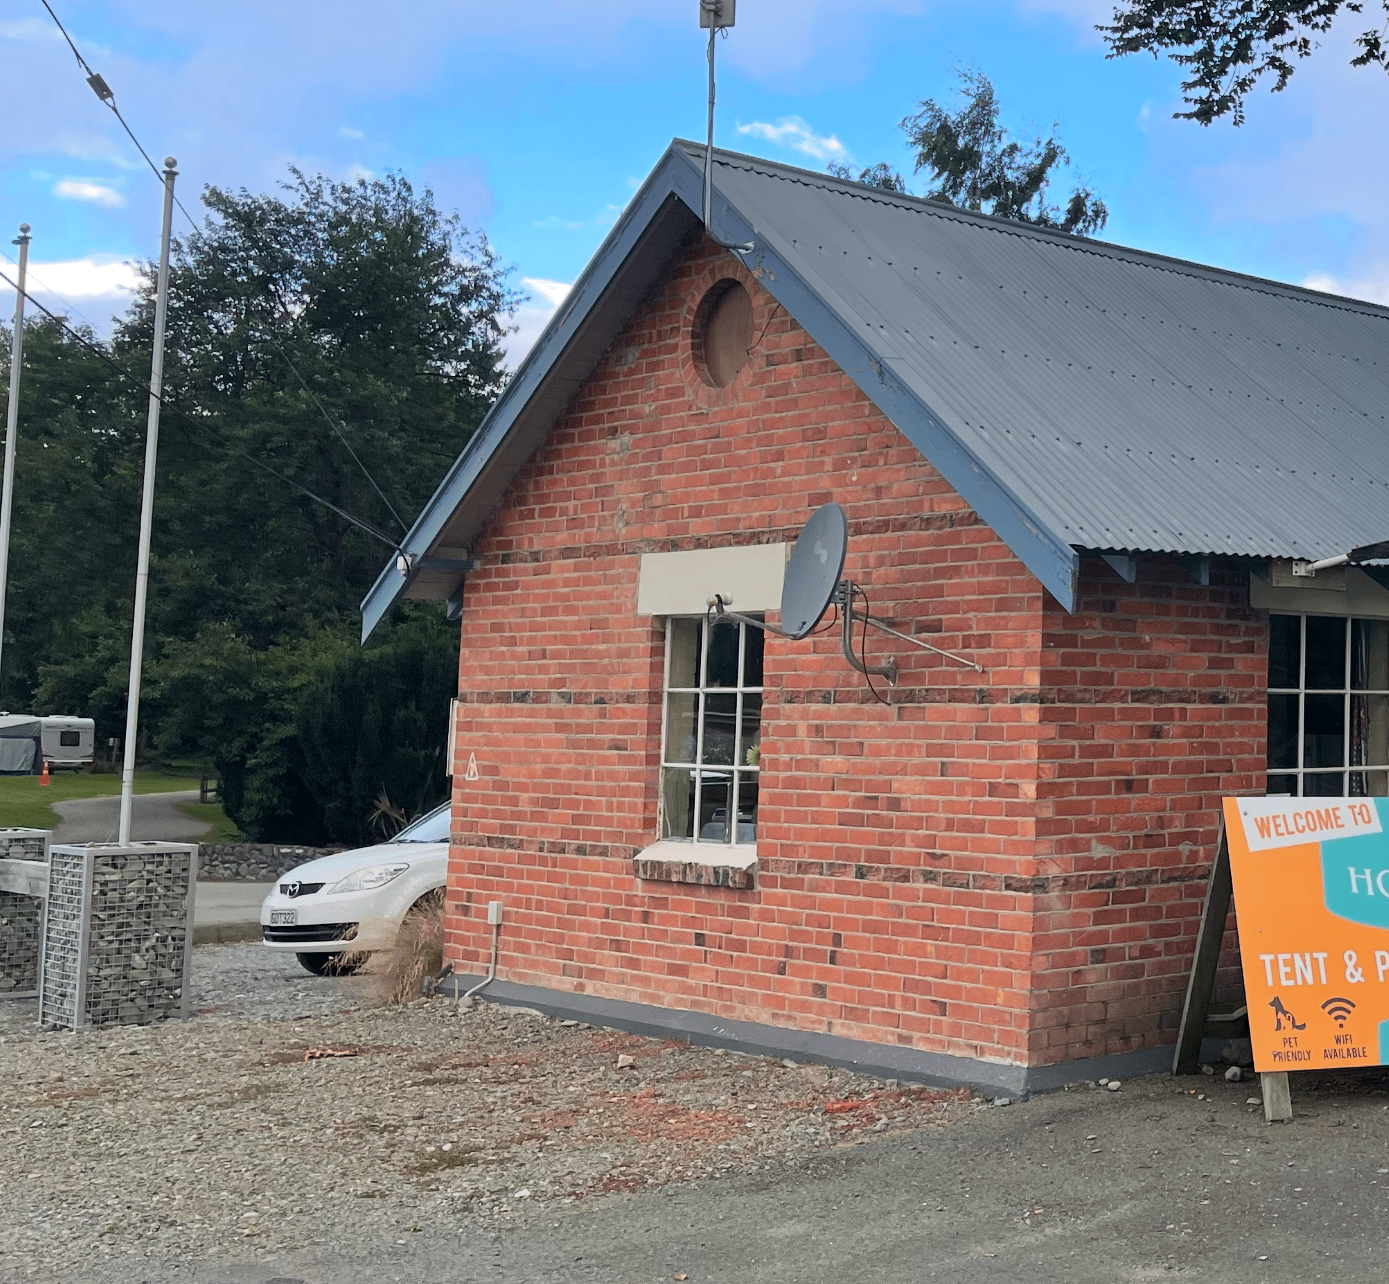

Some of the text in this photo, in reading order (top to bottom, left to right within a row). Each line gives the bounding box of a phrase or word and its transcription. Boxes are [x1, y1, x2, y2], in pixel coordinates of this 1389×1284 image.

[1253, 802, 1373, 839] WELCOME TO
[1259, 951, 1329, 987] TENT
[1343, 949, 1365, 984] &
[1282, 1036, 1298, 1048] PET
[1334, 1034, 1353, 1045] WIFI
[1323, 1046, 1368, 1059] AVAILABLE
